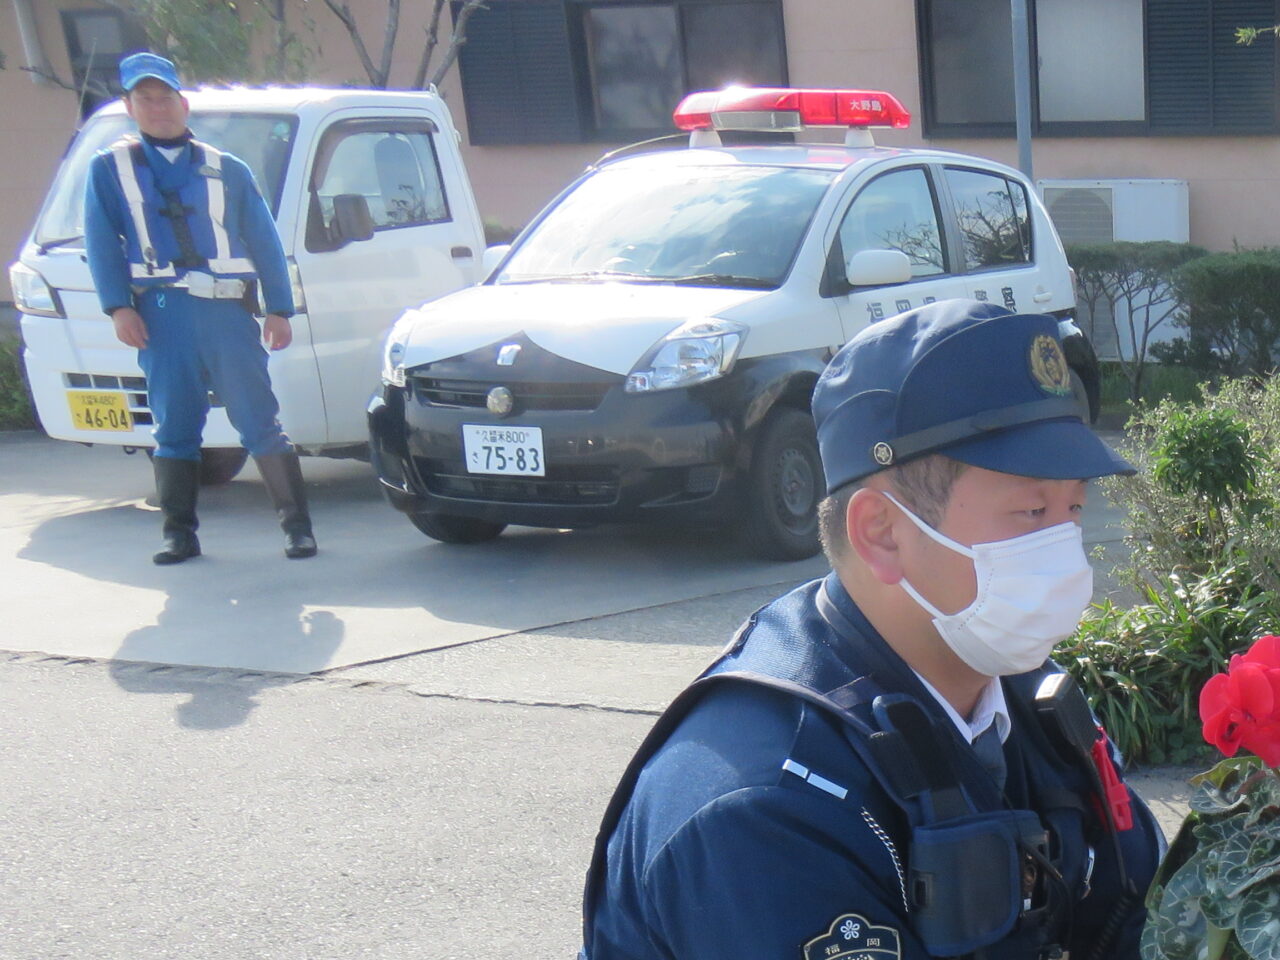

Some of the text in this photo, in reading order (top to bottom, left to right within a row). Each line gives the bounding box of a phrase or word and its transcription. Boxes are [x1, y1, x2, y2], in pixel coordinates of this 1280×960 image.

[86, 408, 128, 428] 46-04
[481, 430, 525, 443] 久留米800
[482, 446, 540, 472] 75-83
